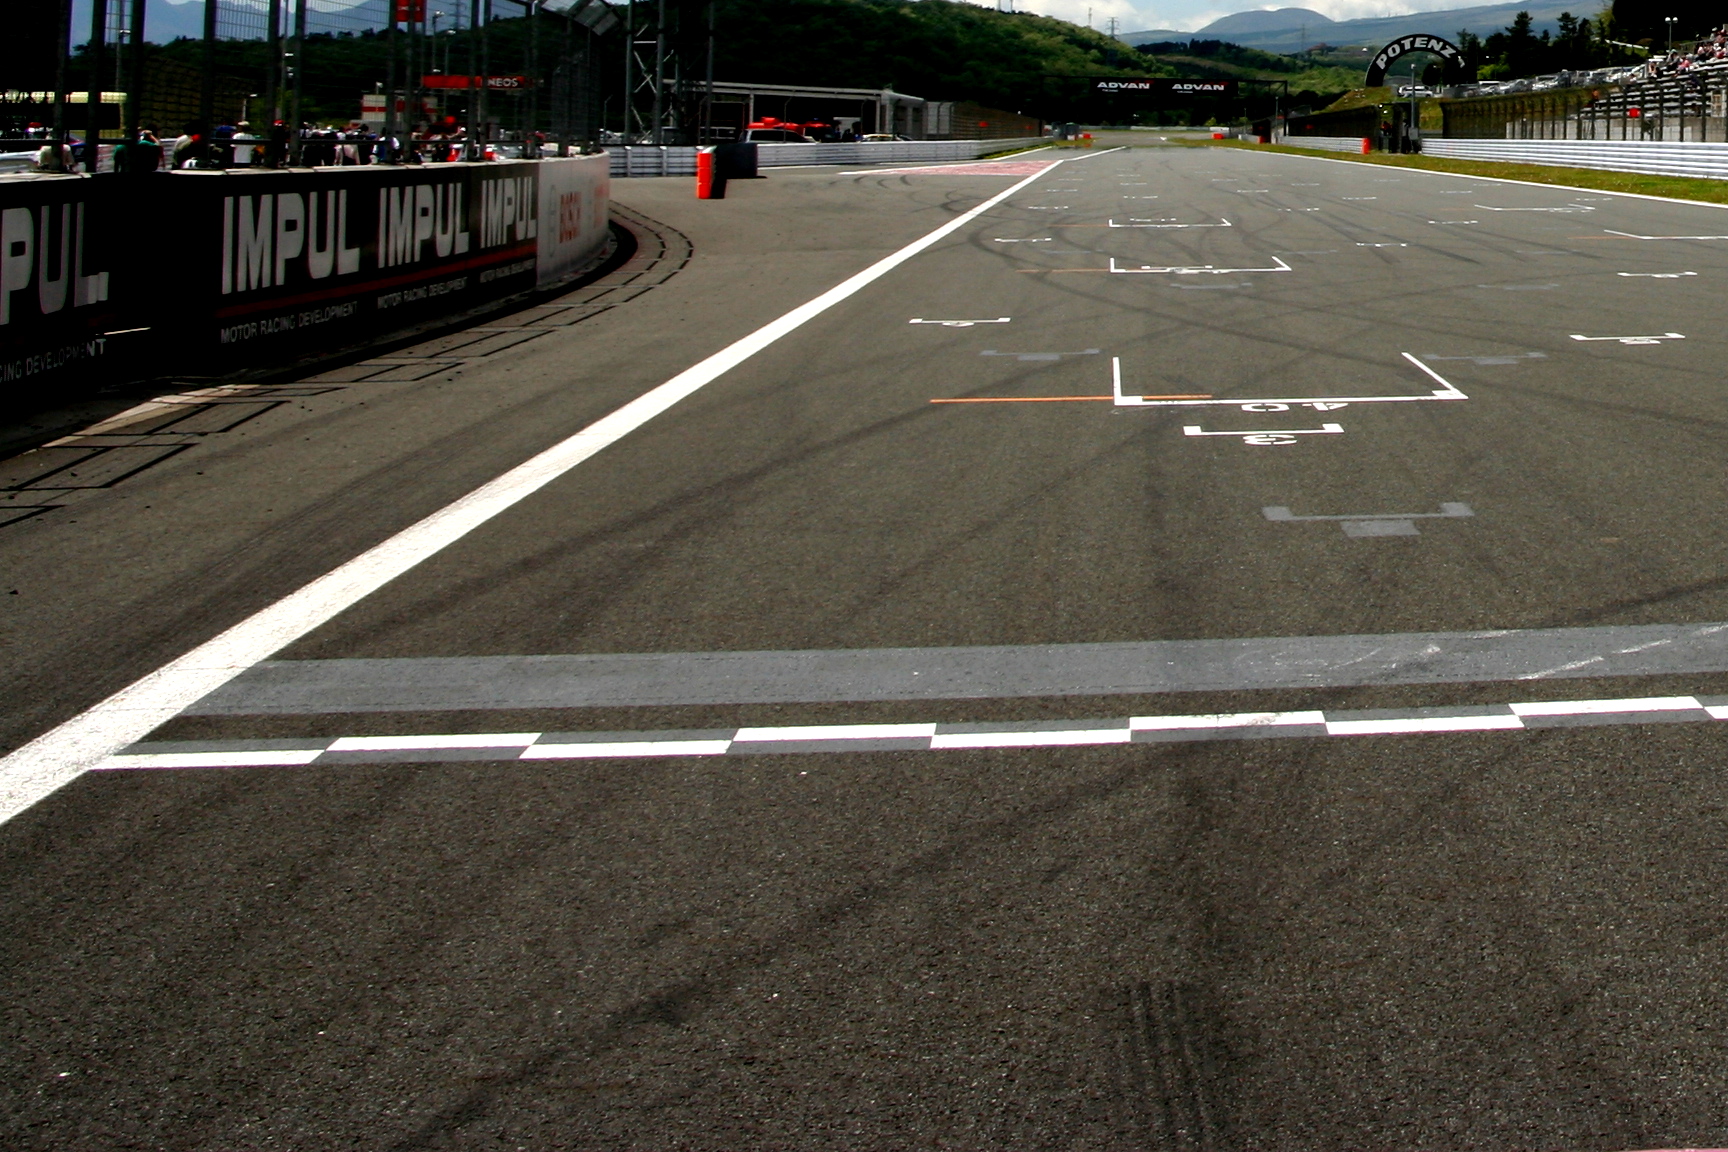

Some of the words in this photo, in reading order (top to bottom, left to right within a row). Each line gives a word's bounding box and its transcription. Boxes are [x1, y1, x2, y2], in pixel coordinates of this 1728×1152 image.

[481, 77, 518, 87] NEOS
[222, 189, 360, 295] IMPUL
[378, 182, 469, 269] IMPUL
[480, 176, 537, 249] IMPUL
[221, 322, 258, 344] MOTOR
[260, 314, 296, 335] RACING
[299, 300, 358, 328] DEVELOPMENT
[26, 338, 106, 376] DEVELOPMENT
